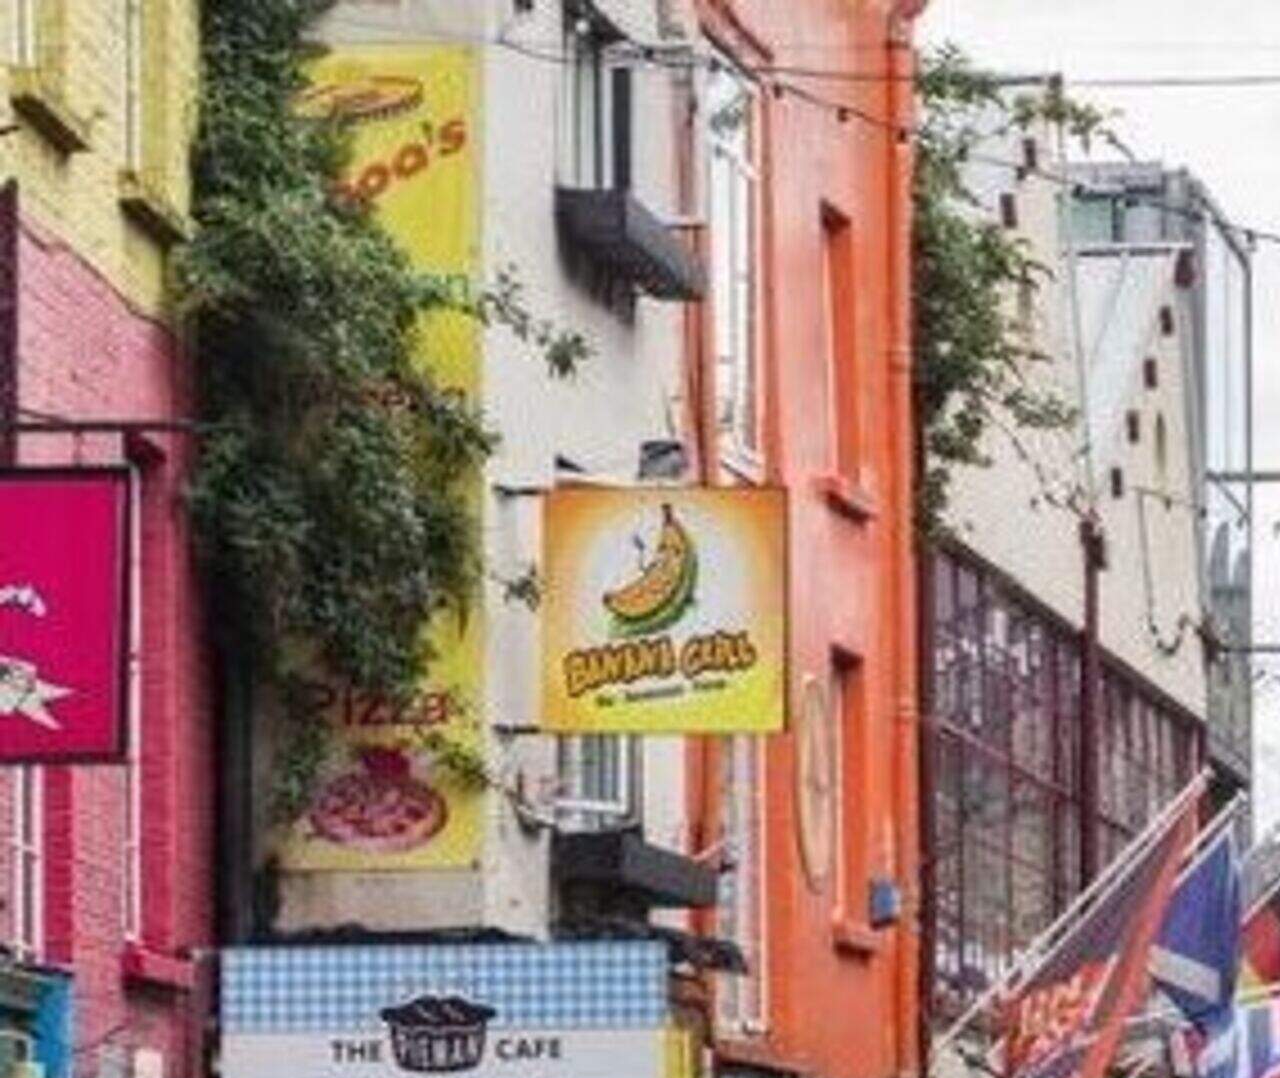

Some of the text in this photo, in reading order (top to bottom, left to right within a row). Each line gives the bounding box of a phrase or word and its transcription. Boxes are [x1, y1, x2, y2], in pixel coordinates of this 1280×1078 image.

[563, 634, 676, 698] BANANA
[331, 1040, 382, 1063] THE
[495, 1038, 562, 1060] CAFE
